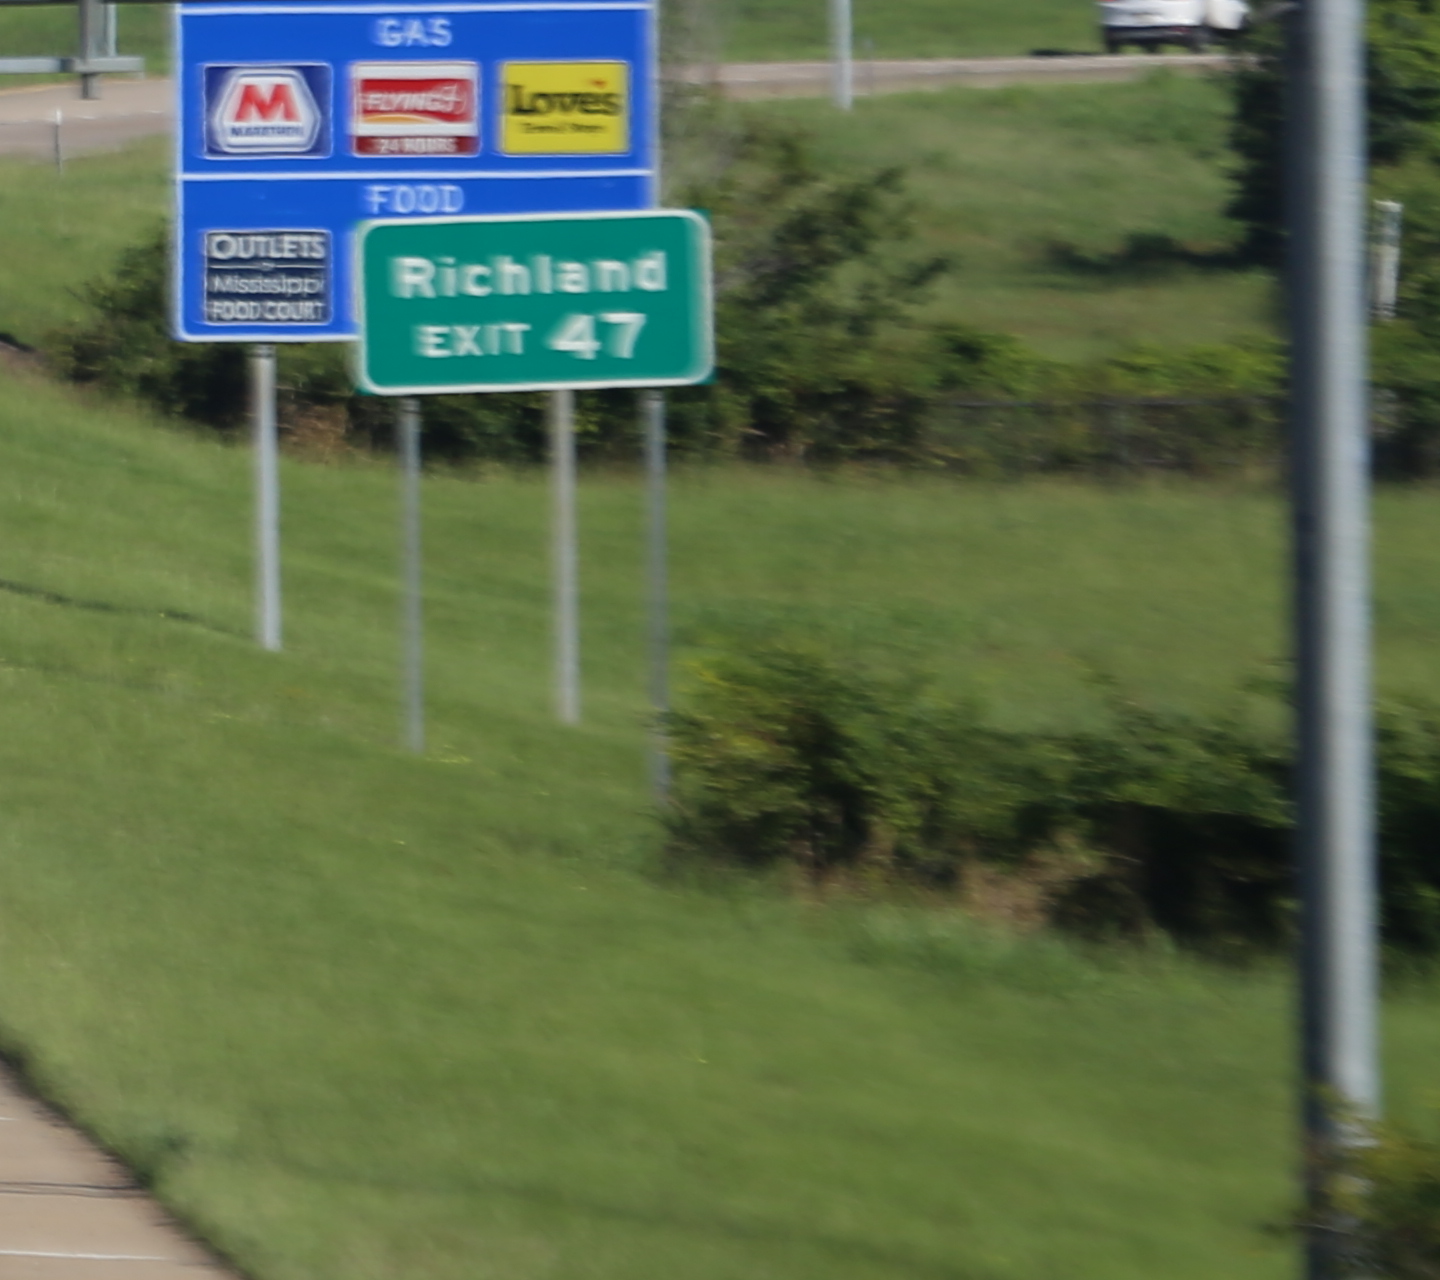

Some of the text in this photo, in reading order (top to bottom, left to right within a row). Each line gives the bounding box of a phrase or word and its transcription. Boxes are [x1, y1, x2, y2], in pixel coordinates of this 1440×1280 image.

[378, 18, 453, 48] GAS
[233, 83, 302, 123] M
[368, 184, 464, 214] FOOD
[211, 234, 326, 260] OUTLETS
[391, 250, 669, 298] Richland
[211, 301, 325, 320] FOOD COURT
[414, 312, 647, 360] EXIT 47
